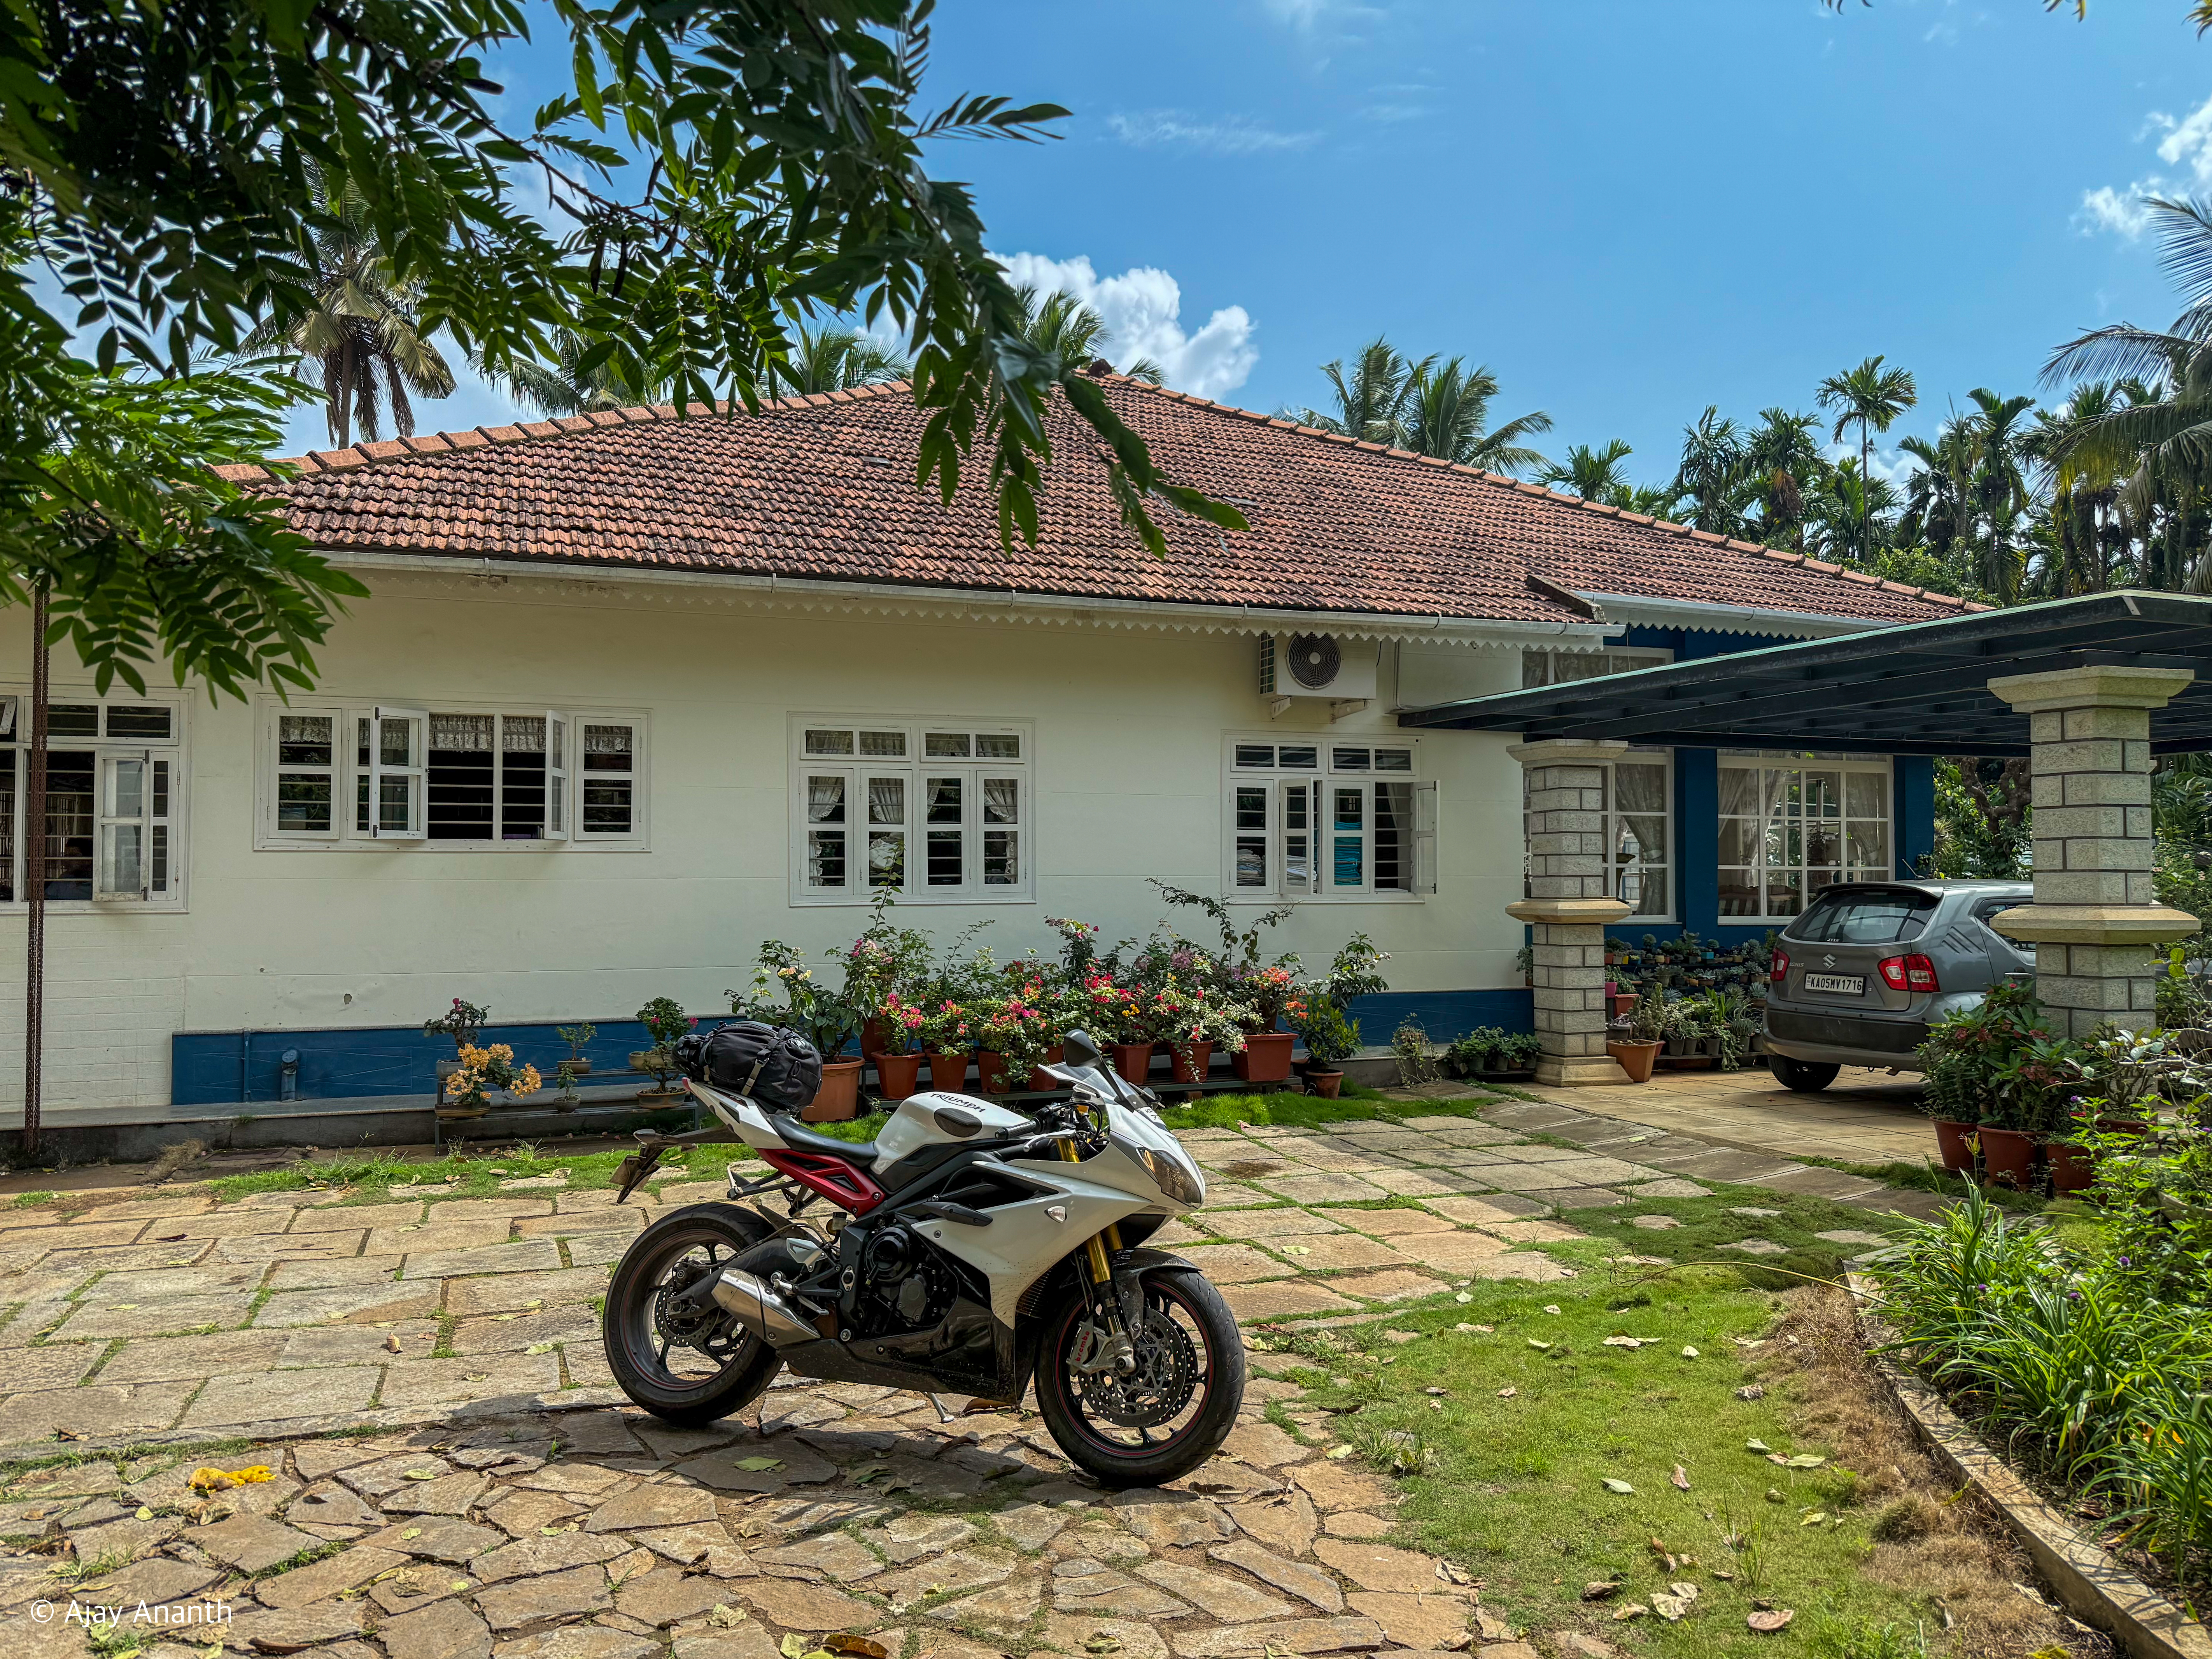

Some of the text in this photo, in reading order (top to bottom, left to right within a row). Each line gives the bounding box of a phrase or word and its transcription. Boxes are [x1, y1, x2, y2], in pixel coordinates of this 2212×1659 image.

[1810, 977, 1862, 991] KA05MV1716
[930, 1093, 986, 1112] TRIUMPH
[1075, 1331, 1090, 1361] brembo
